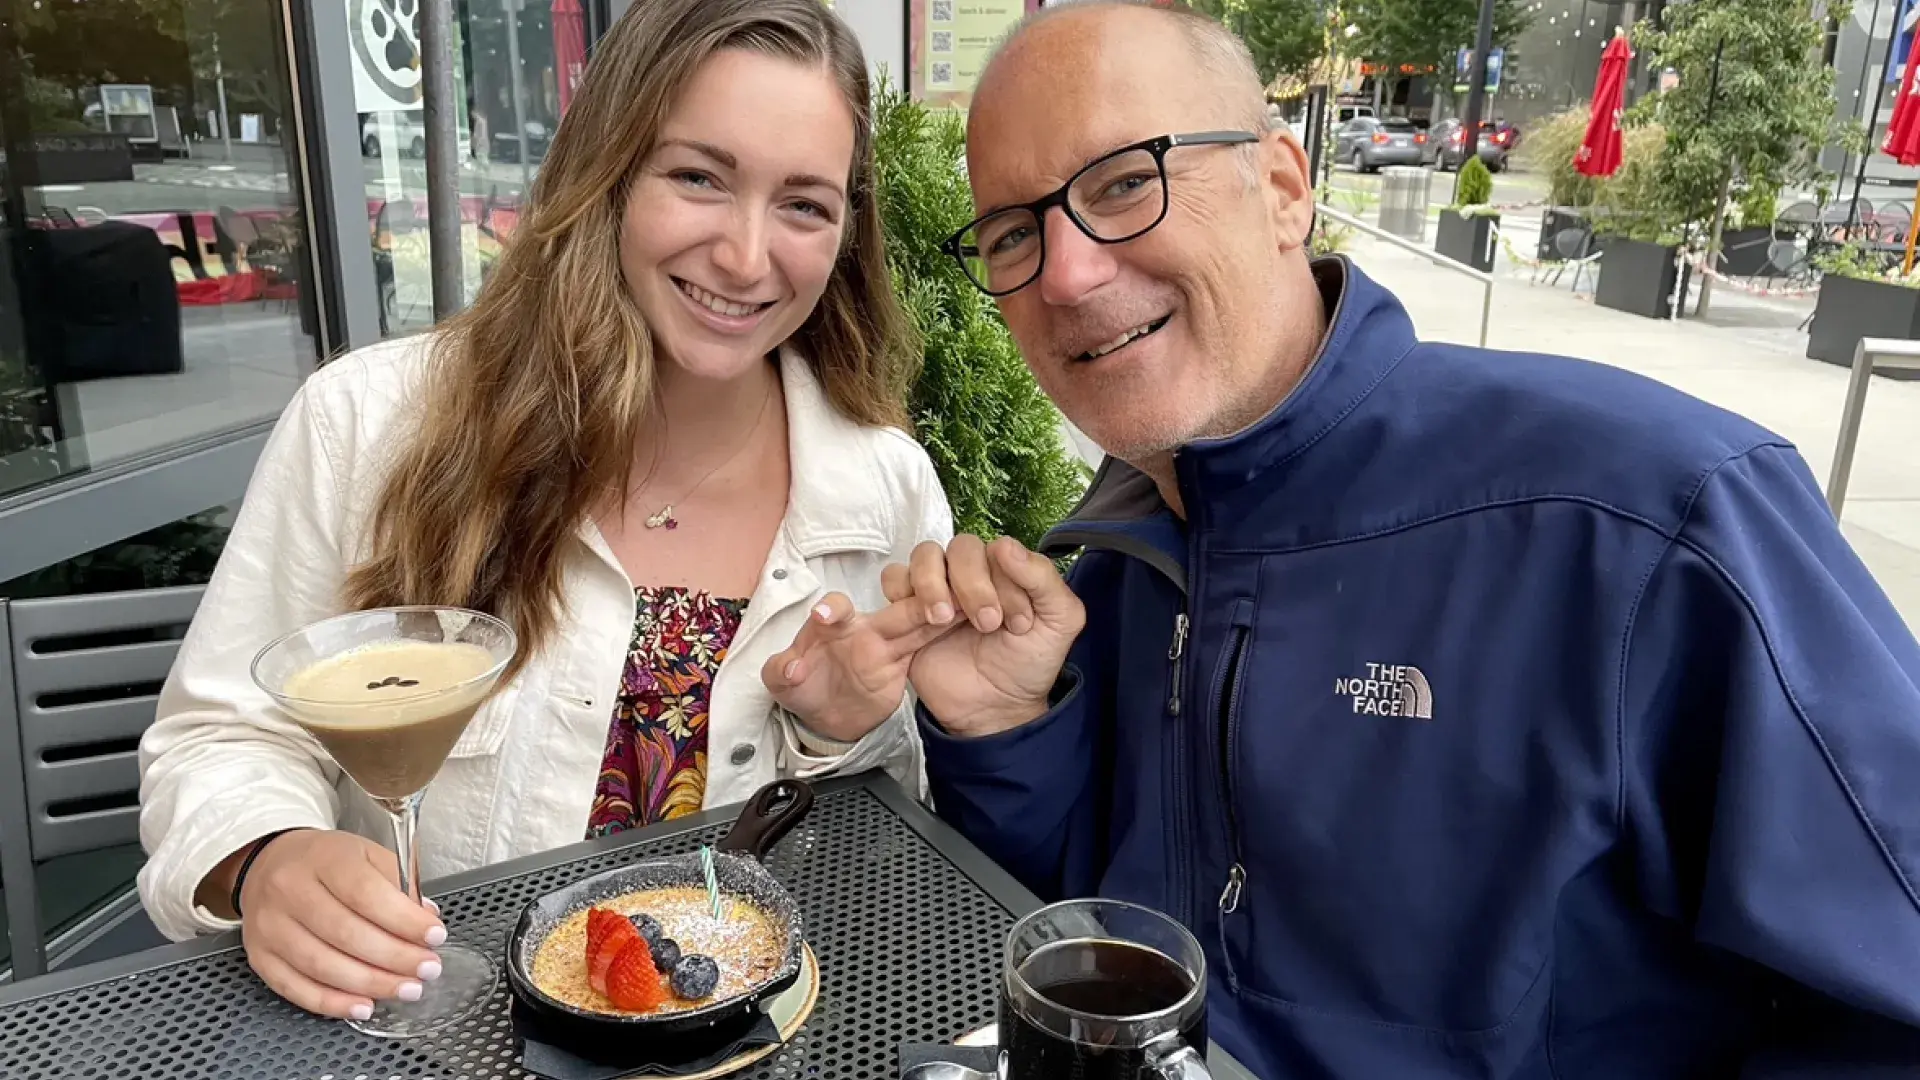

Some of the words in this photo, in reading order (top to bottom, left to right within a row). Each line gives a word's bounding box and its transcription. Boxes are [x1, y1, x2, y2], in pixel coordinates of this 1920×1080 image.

[1366, 662, 1406, 682] THE
[1334, 677, 1403, 699] NORTH
[1353, 696, 1401, 717] FACE
